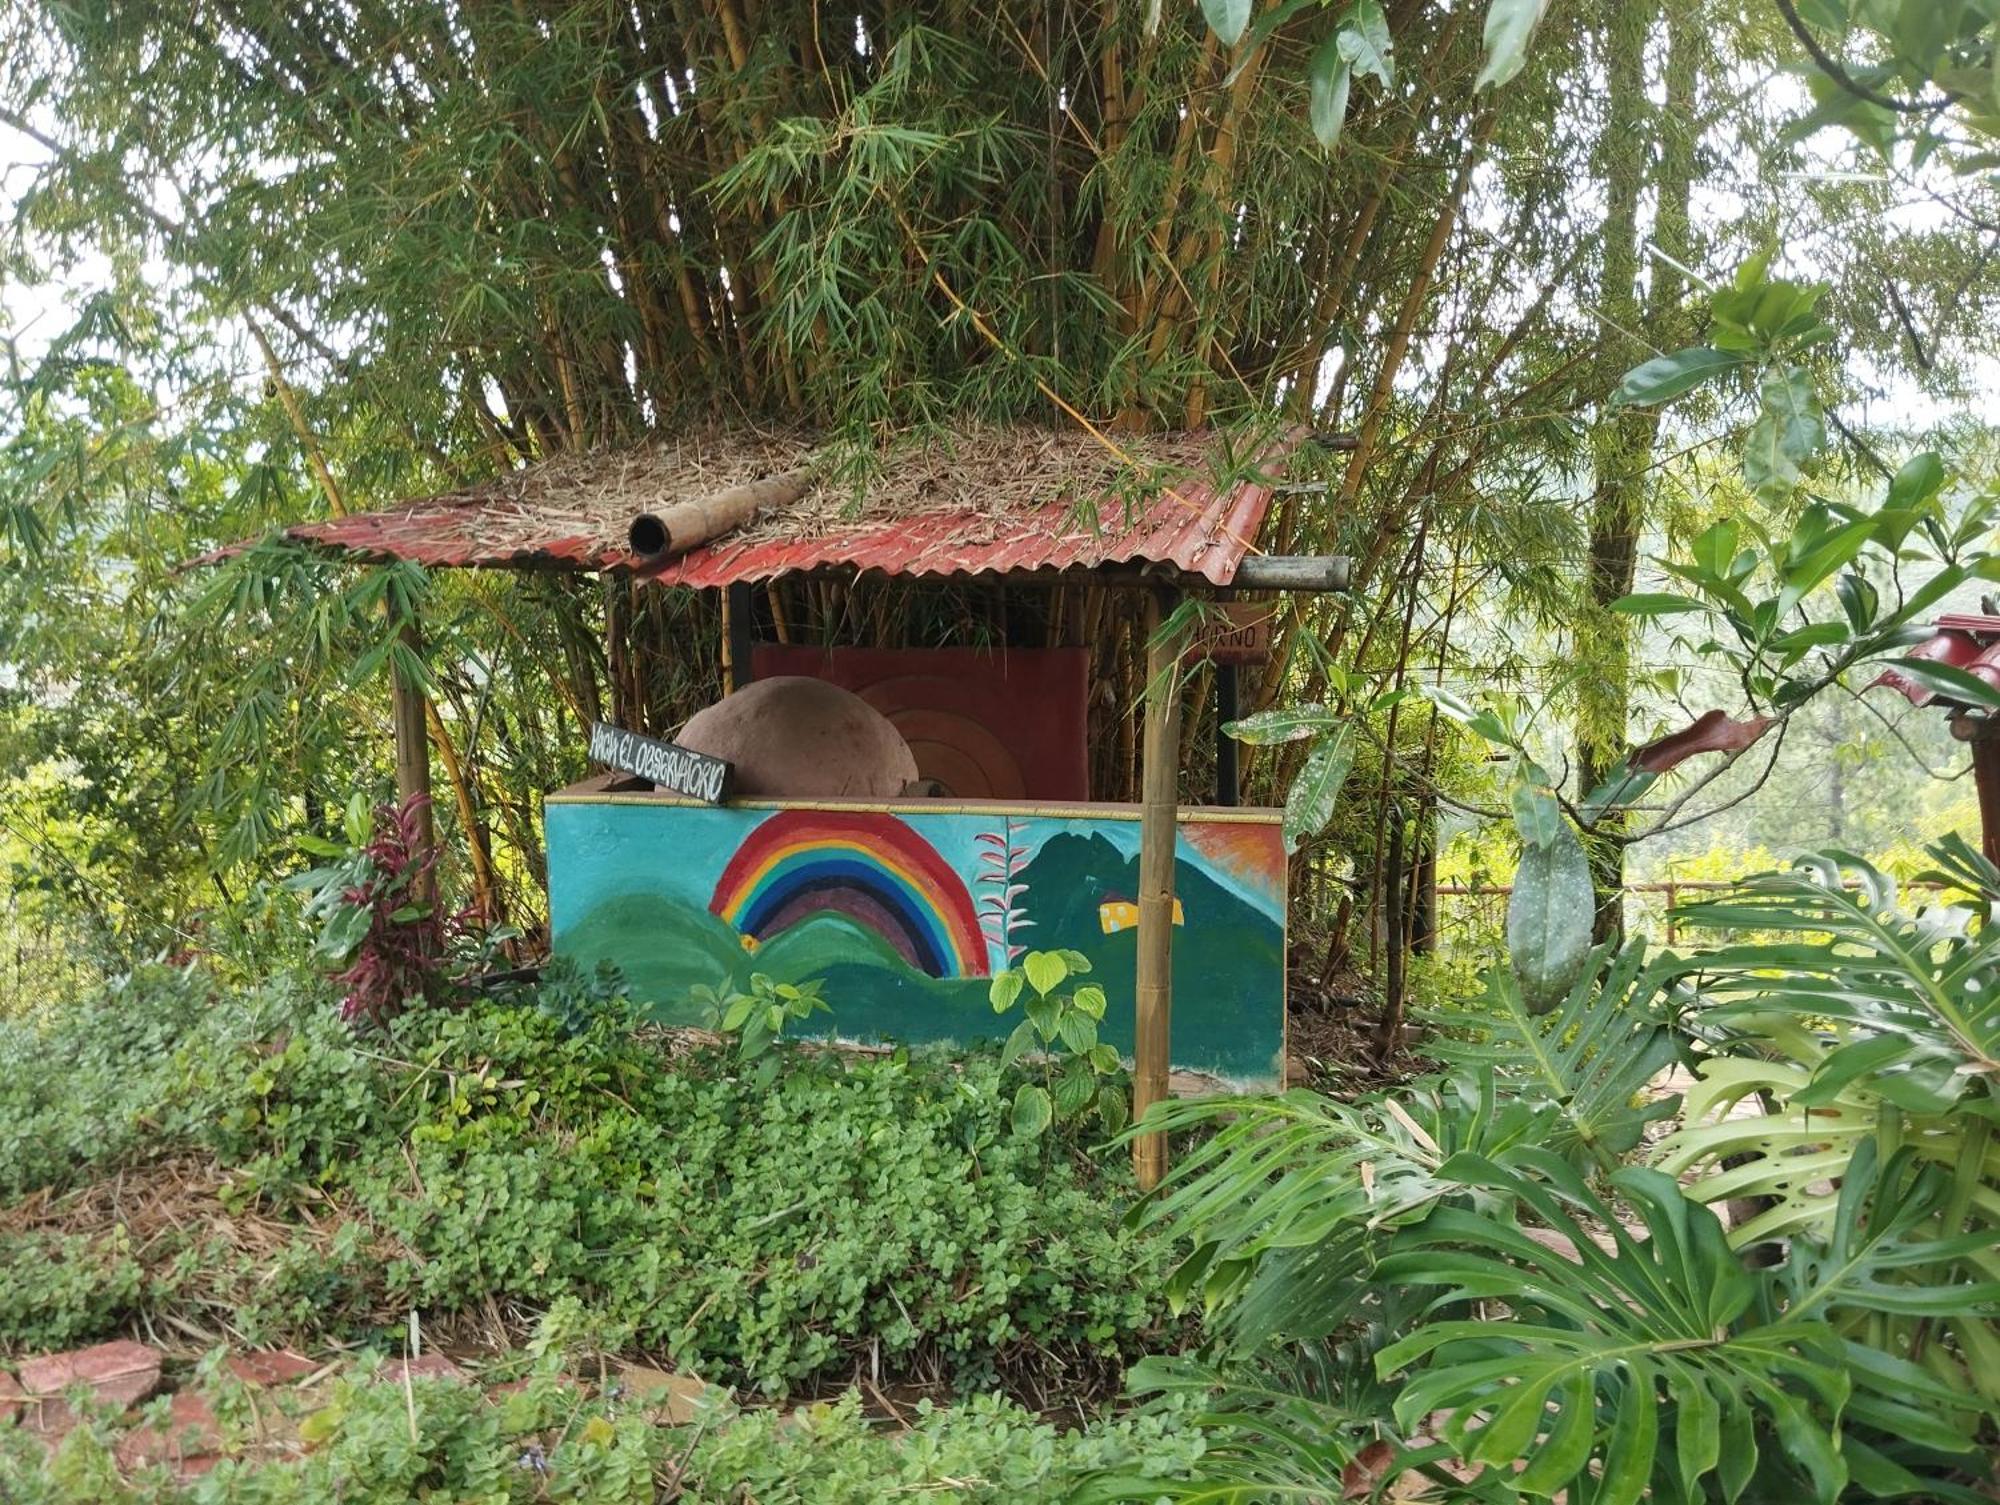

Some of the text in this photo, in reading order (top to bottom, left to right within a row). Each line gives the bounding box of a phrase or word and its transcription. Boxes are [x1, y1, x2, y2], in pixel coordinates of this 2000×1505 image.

[588, 721, 726, 801] HACIA EL OBSERVATORIO
